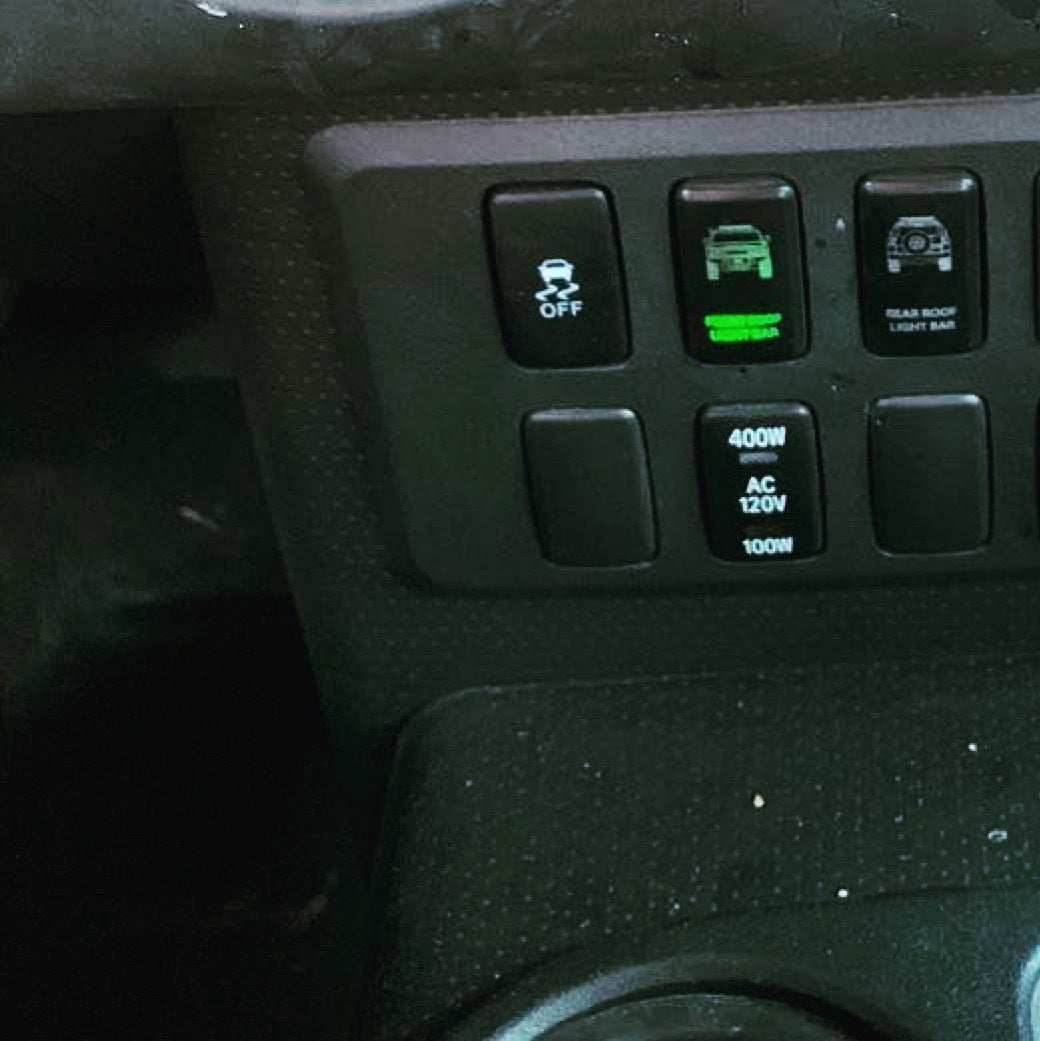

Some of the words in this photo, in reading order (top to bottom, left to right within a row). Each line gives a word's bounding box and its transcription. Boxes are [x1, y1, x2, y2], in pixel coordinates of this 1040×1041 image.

[539, 300, 583, 319] OFF
[889, 321, 927, 332] LIGHT
[930, 320, 956, 332] BAR
[728, 426, 786, 449] 400W
[746, 475, 776, 494] AC
[738, 493, 787, 514] 120V
[742, 536, 794, 556] 100W
